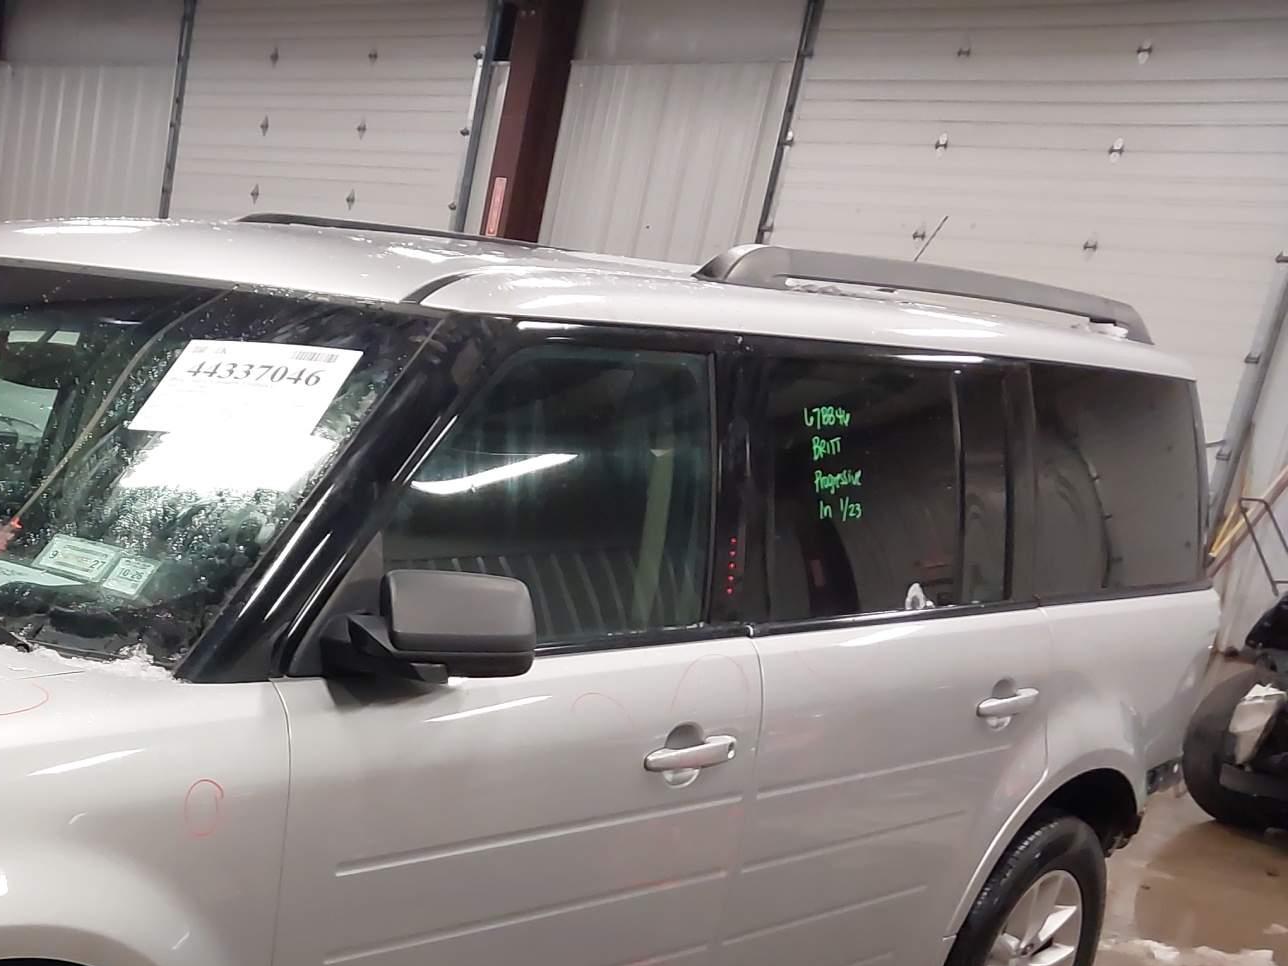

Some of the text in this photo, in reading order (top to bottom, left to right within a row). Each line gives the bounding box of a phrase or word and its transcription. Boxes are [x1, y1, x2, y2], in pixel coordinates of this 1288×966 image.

[186, 360, 327, 387] 44337046
[812, 436, 842, 461] BRITT
[839, 496, 862, 522] 1/23
